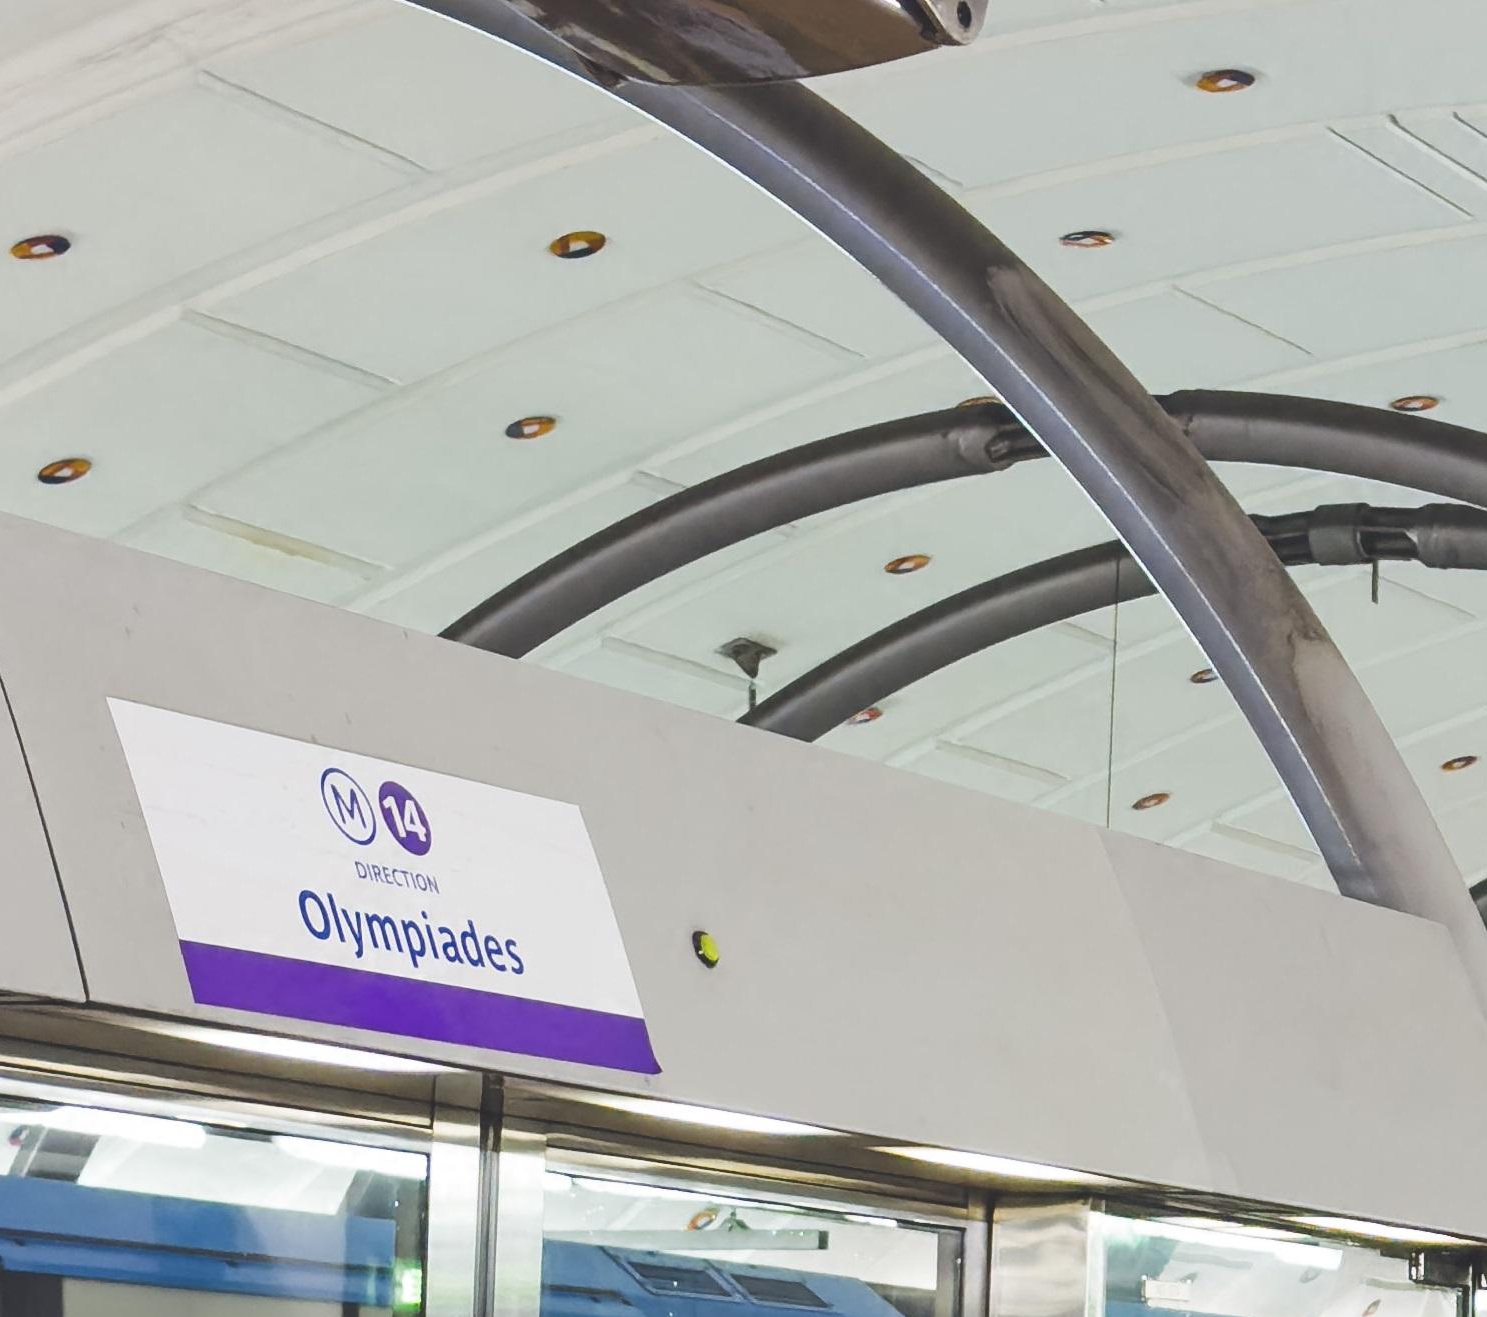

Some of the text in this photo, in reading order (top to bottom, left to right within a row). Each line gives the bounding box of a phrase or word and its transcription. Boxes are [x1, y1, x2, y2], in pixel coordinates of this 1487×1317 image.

[382, 795, 427, 842] 14
[354, 861, 440, 895] DIRECTION
[298, 889, 524, 975] Olympiades
